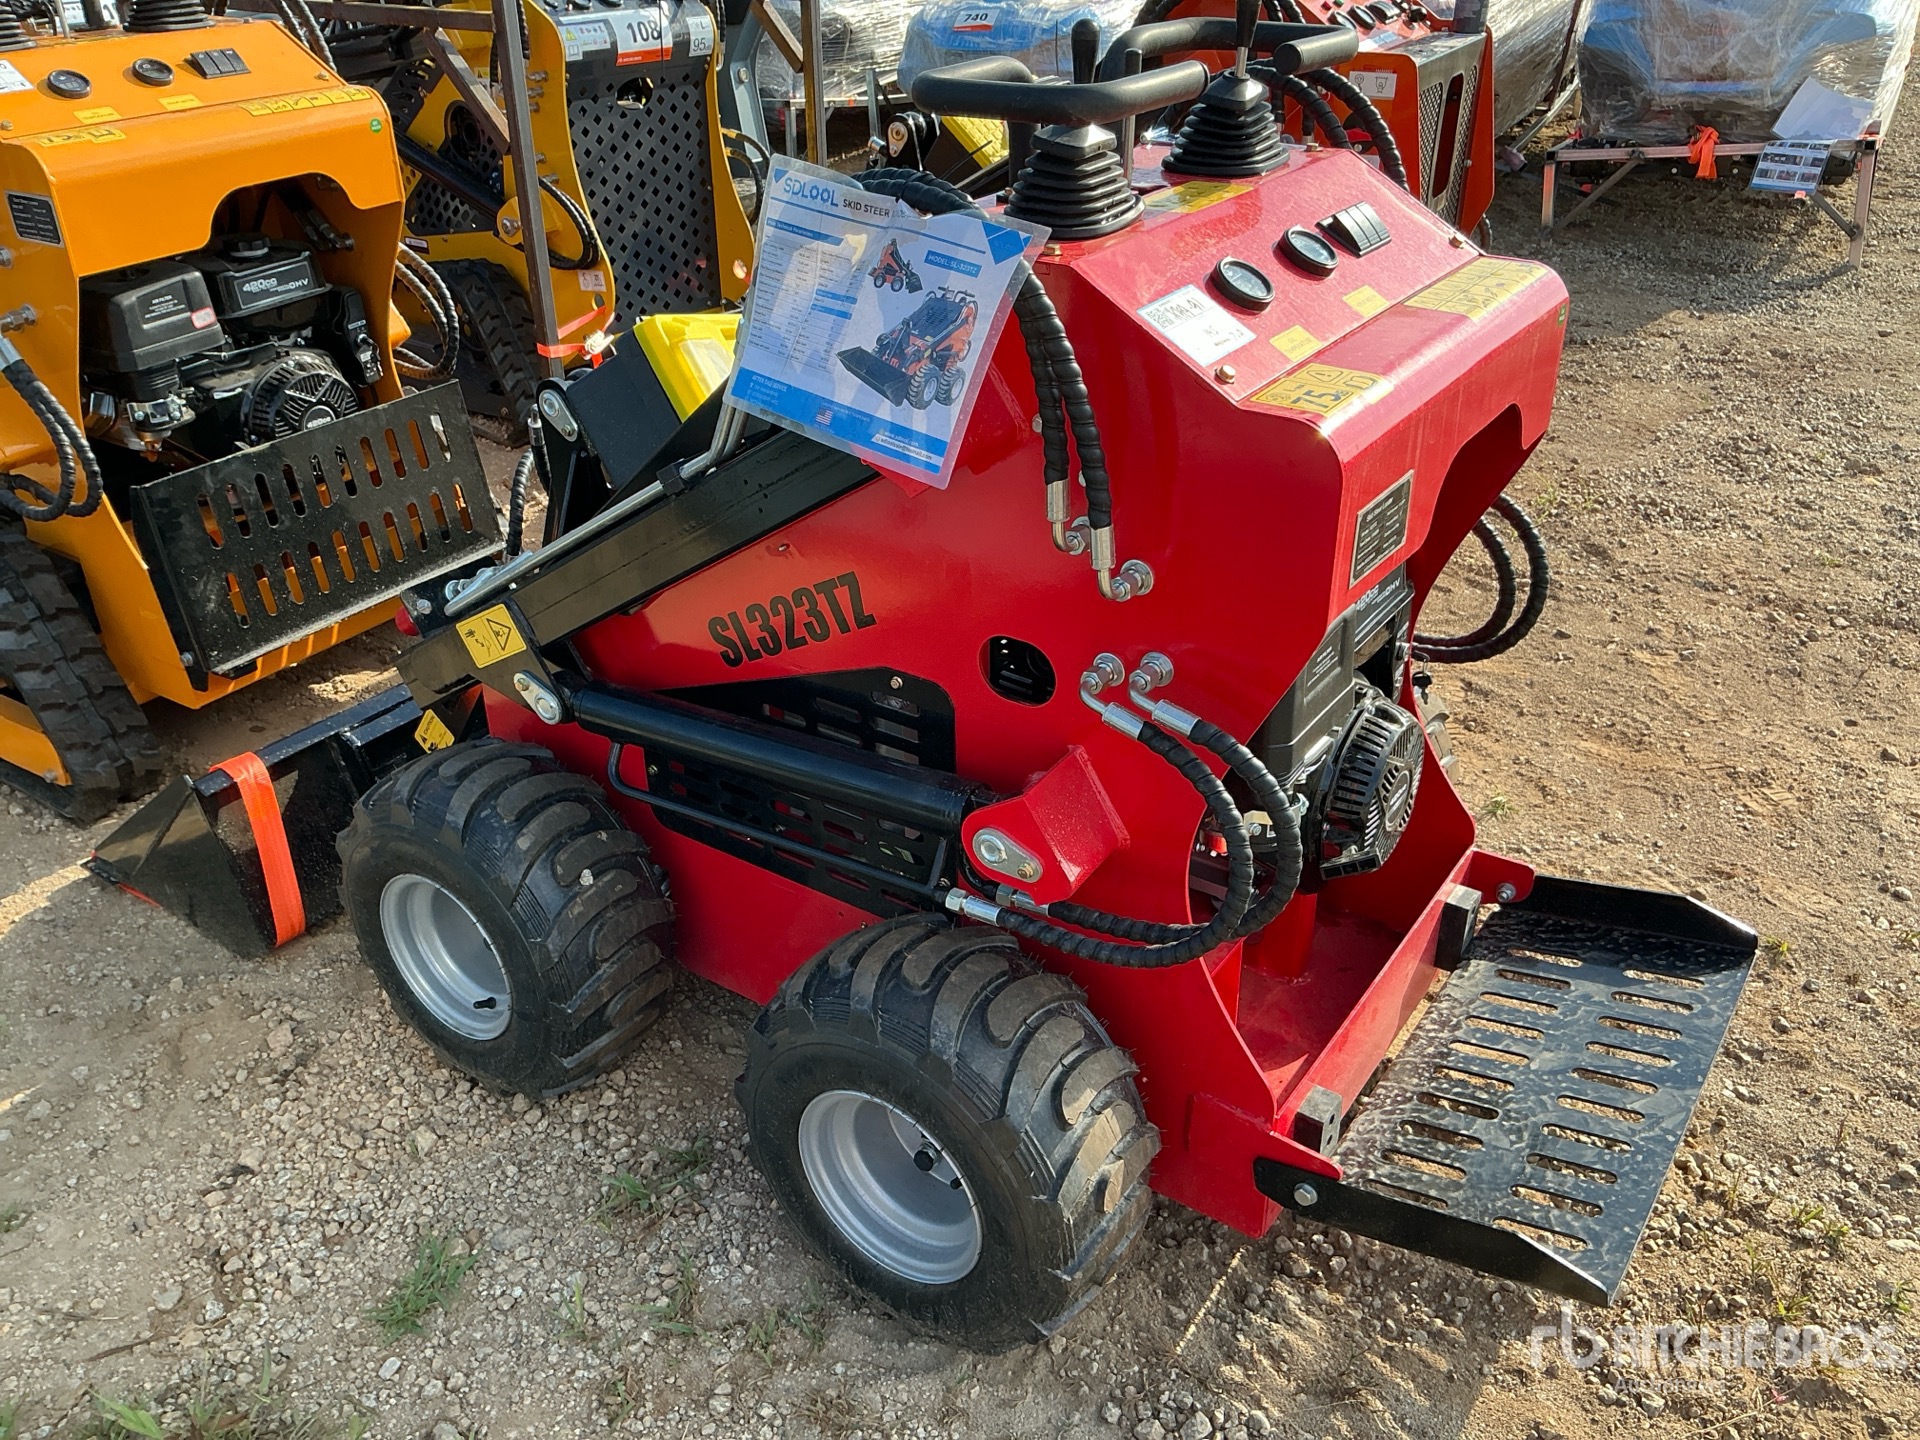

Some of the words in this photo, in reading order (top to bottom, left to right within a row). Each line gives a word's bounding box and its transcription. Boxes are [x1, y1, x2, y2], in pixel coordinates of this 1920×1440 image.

[963, 12, 988, 23] 740
[626, 20, 662, 43] 108
[692, 37, 706, 52] 95
[783, 177, 839, 207] SDLOOL
[843, 198, 862, 211] SKID
[863, 204, 890, 218] STEER
[243, 277, 278, 291] 420cc
[289, 277, 309, 289] OHV
[1385, 576, 1400, 595] OHV
[708, 570, 877, 668] SL323TZ
